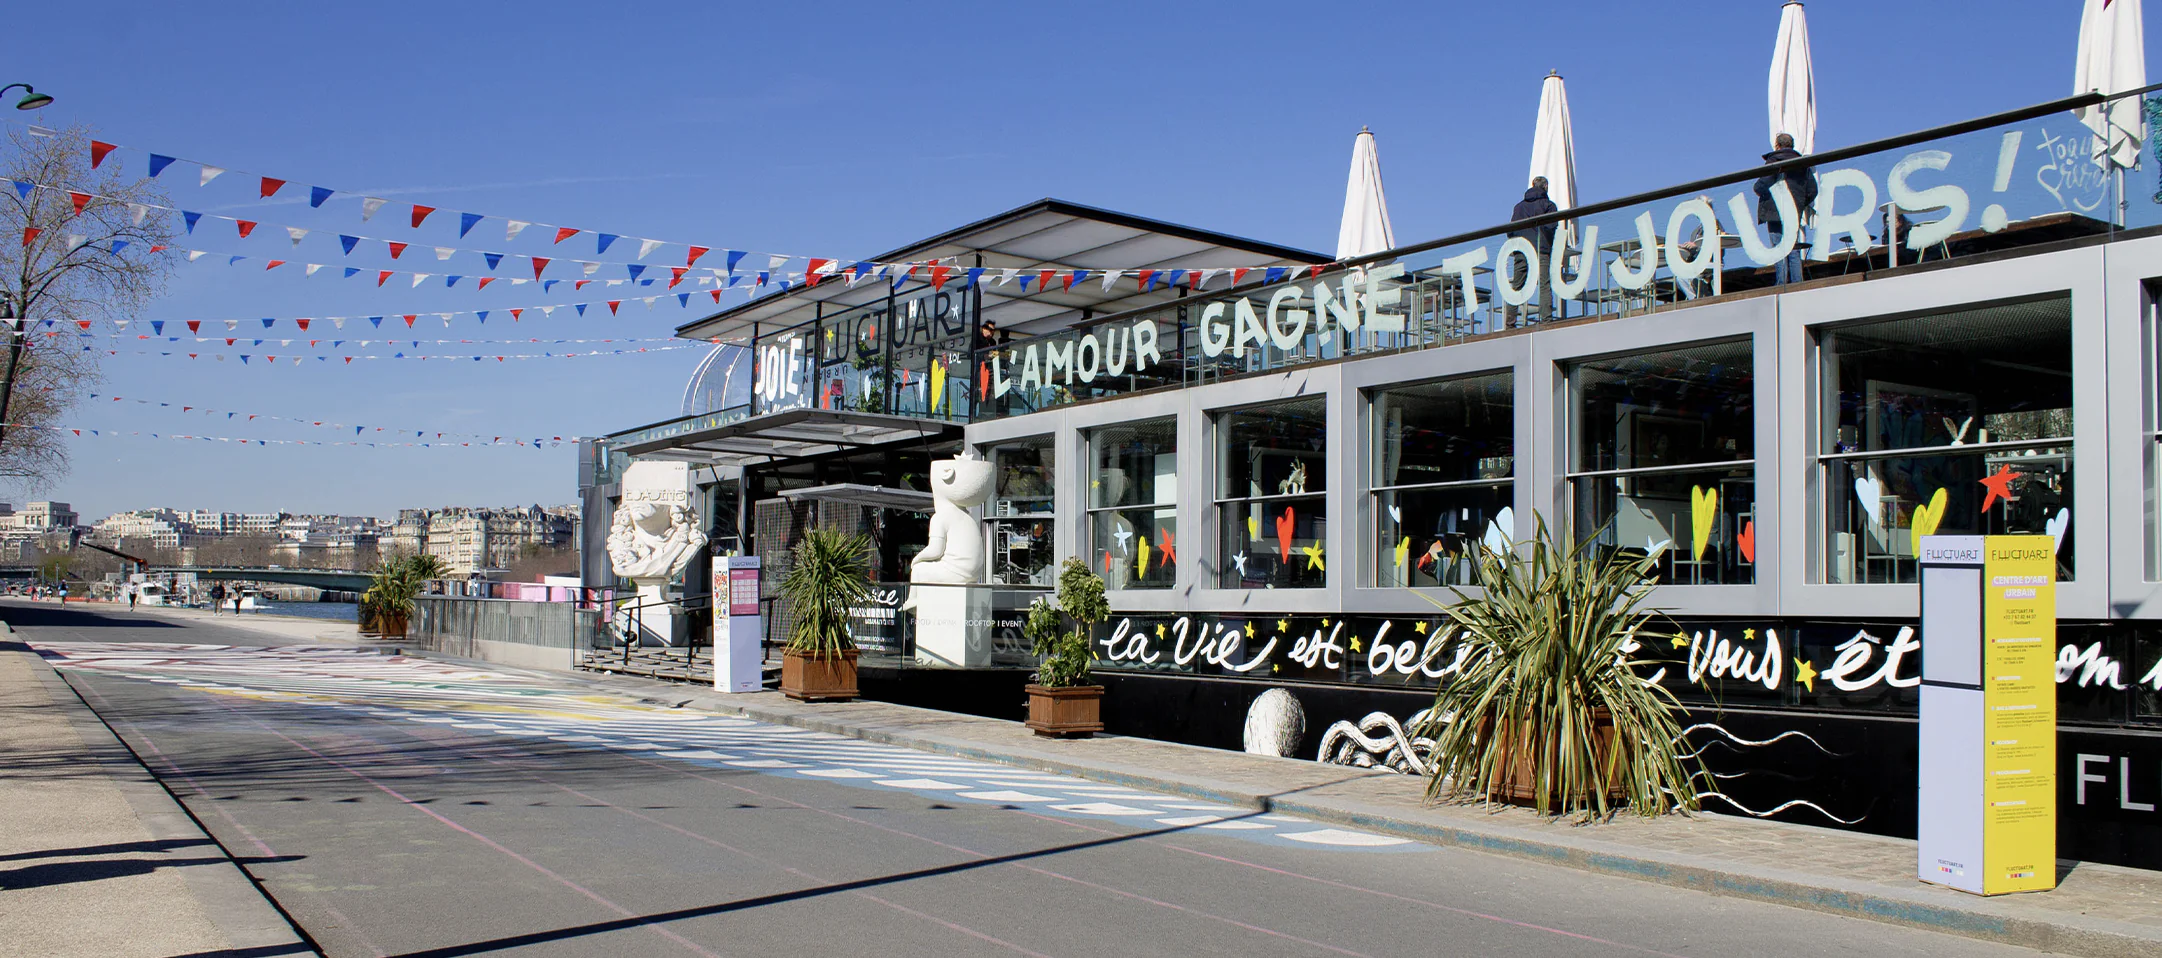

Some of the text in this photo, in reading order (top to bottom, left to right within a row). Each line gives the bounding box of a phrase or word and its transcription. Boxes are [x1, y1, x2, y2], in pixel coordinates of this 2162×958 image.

[992, 319, 1161, 400] L'AMOUR
[1200, 262, 1405, 358] GAGNE
[754, 337, 803, 402] JOIE
[1926, 549, 1979, 559] FLUCTUART
[1991, 549, 2049, 560] FLUCTUART
[1993, 575, 2048, 585] CENTRE D'ART
[2005, 588, 2036, 597] URBAIN
[1001, 620, 1023, 628] EVENT
[1100, 617, 1160, 664] la
[1288, 620, 1344, 669] est
